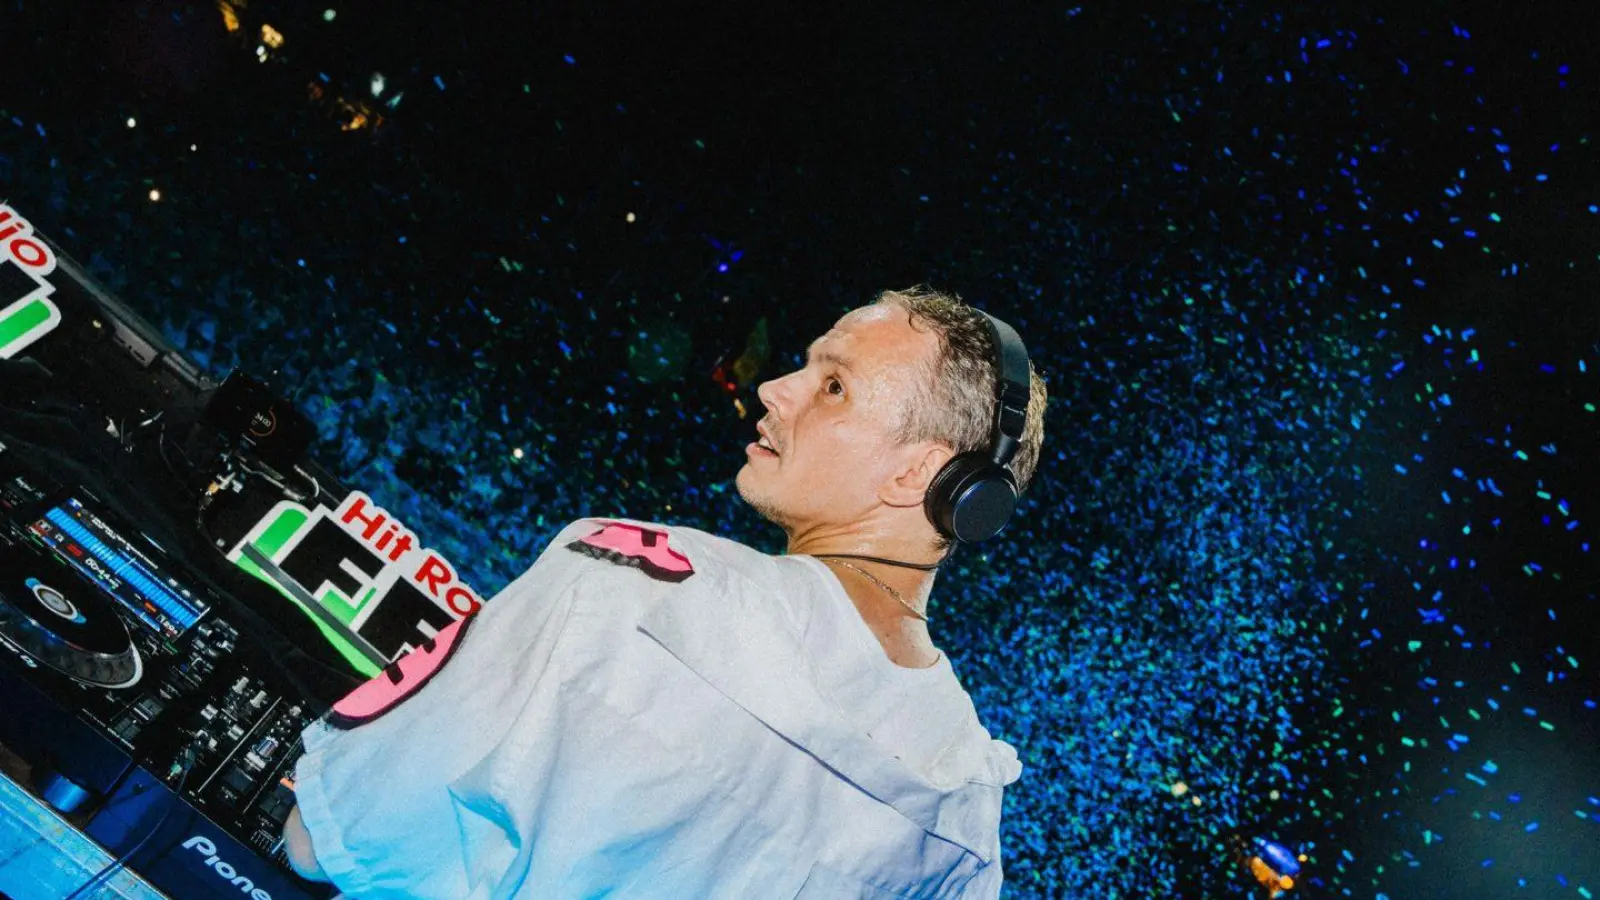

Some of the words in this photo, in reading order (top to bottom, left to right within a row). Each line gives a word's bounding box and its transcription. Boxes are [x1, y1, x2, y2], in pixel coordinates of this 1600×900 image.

[278, 514, 459, 665] FF
[341, 498, 412, 562] Hit
[415, 555, 482, 617] Ra
[182, 836, 272, 900] Pione
